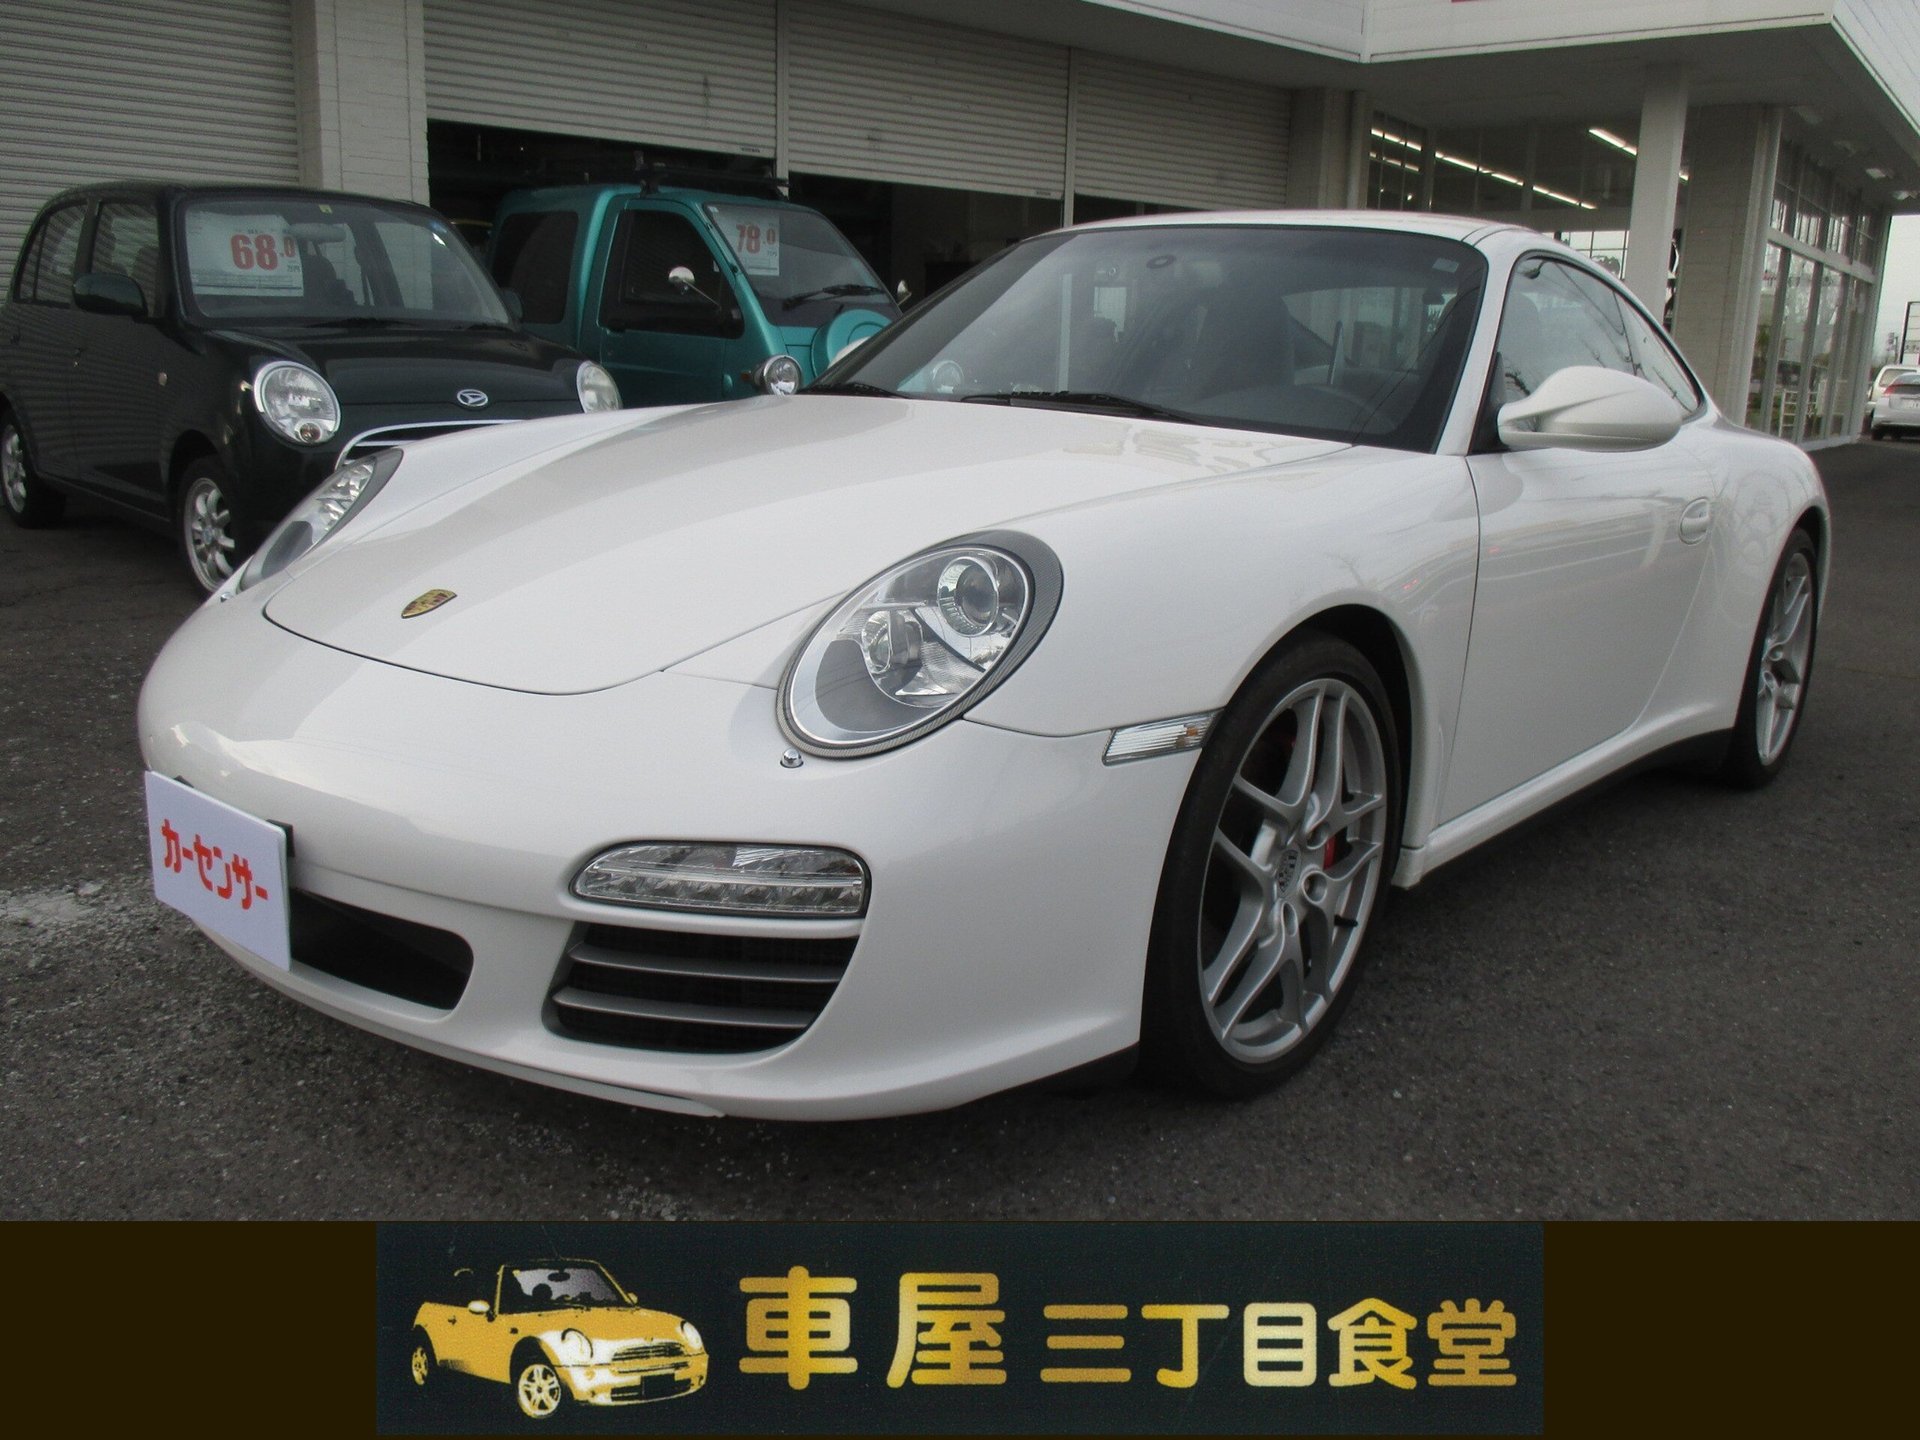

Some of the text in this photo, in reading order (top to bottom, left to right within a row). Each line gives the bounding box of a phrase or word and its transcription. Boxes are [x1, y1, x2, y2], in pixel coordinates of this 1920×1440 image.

[162, 818, 268, 910] カーセンサー
